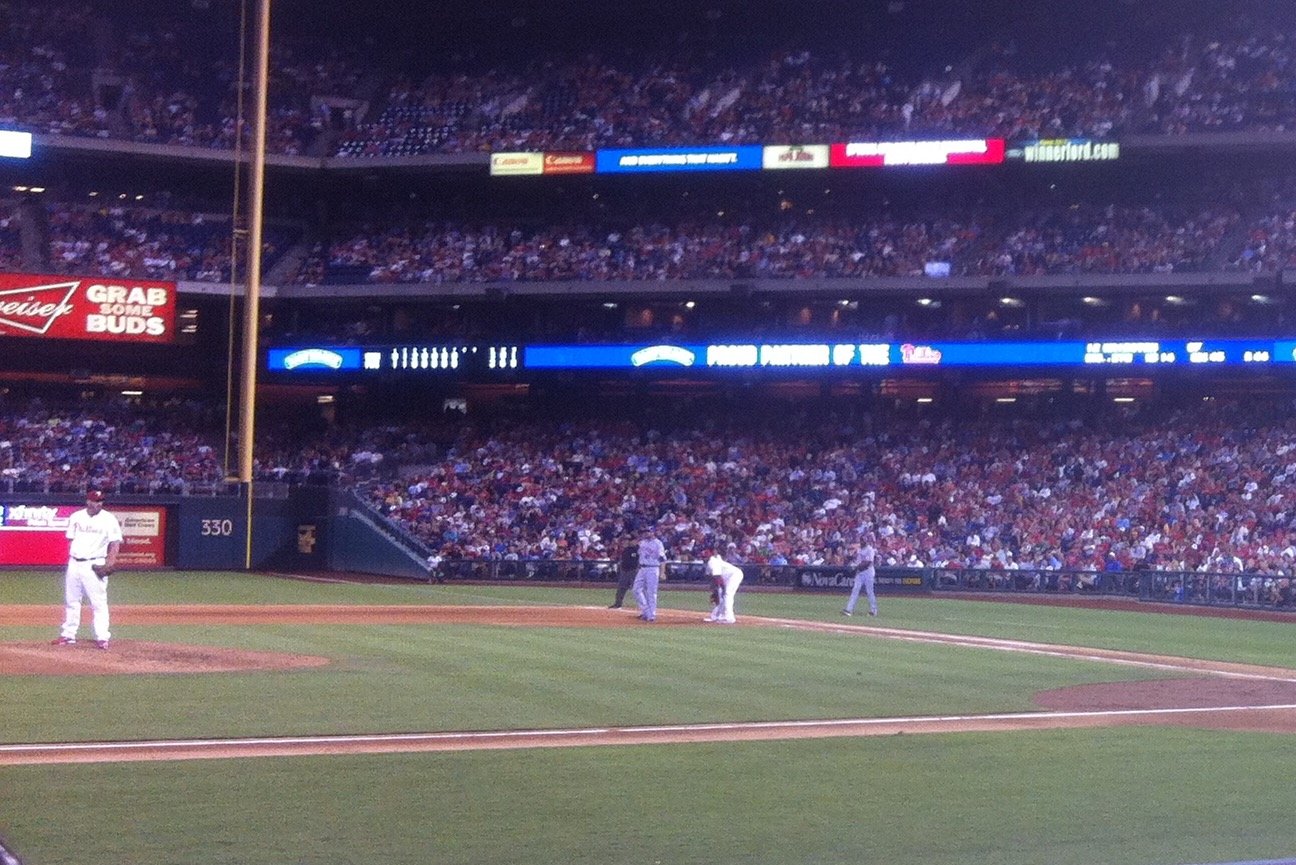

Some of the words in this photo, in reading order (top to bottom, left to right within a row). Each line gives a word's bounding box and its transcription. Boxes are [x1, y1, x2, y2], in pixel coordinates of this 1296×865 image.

[1025, 141, 1119, 162] winnerford.com
[86, 285, 167, 305] GRAB
[99, 303, 154, 316] SOME
[85, 314, 165, 335] BUDS
[201, 519, 232, 536] 330
